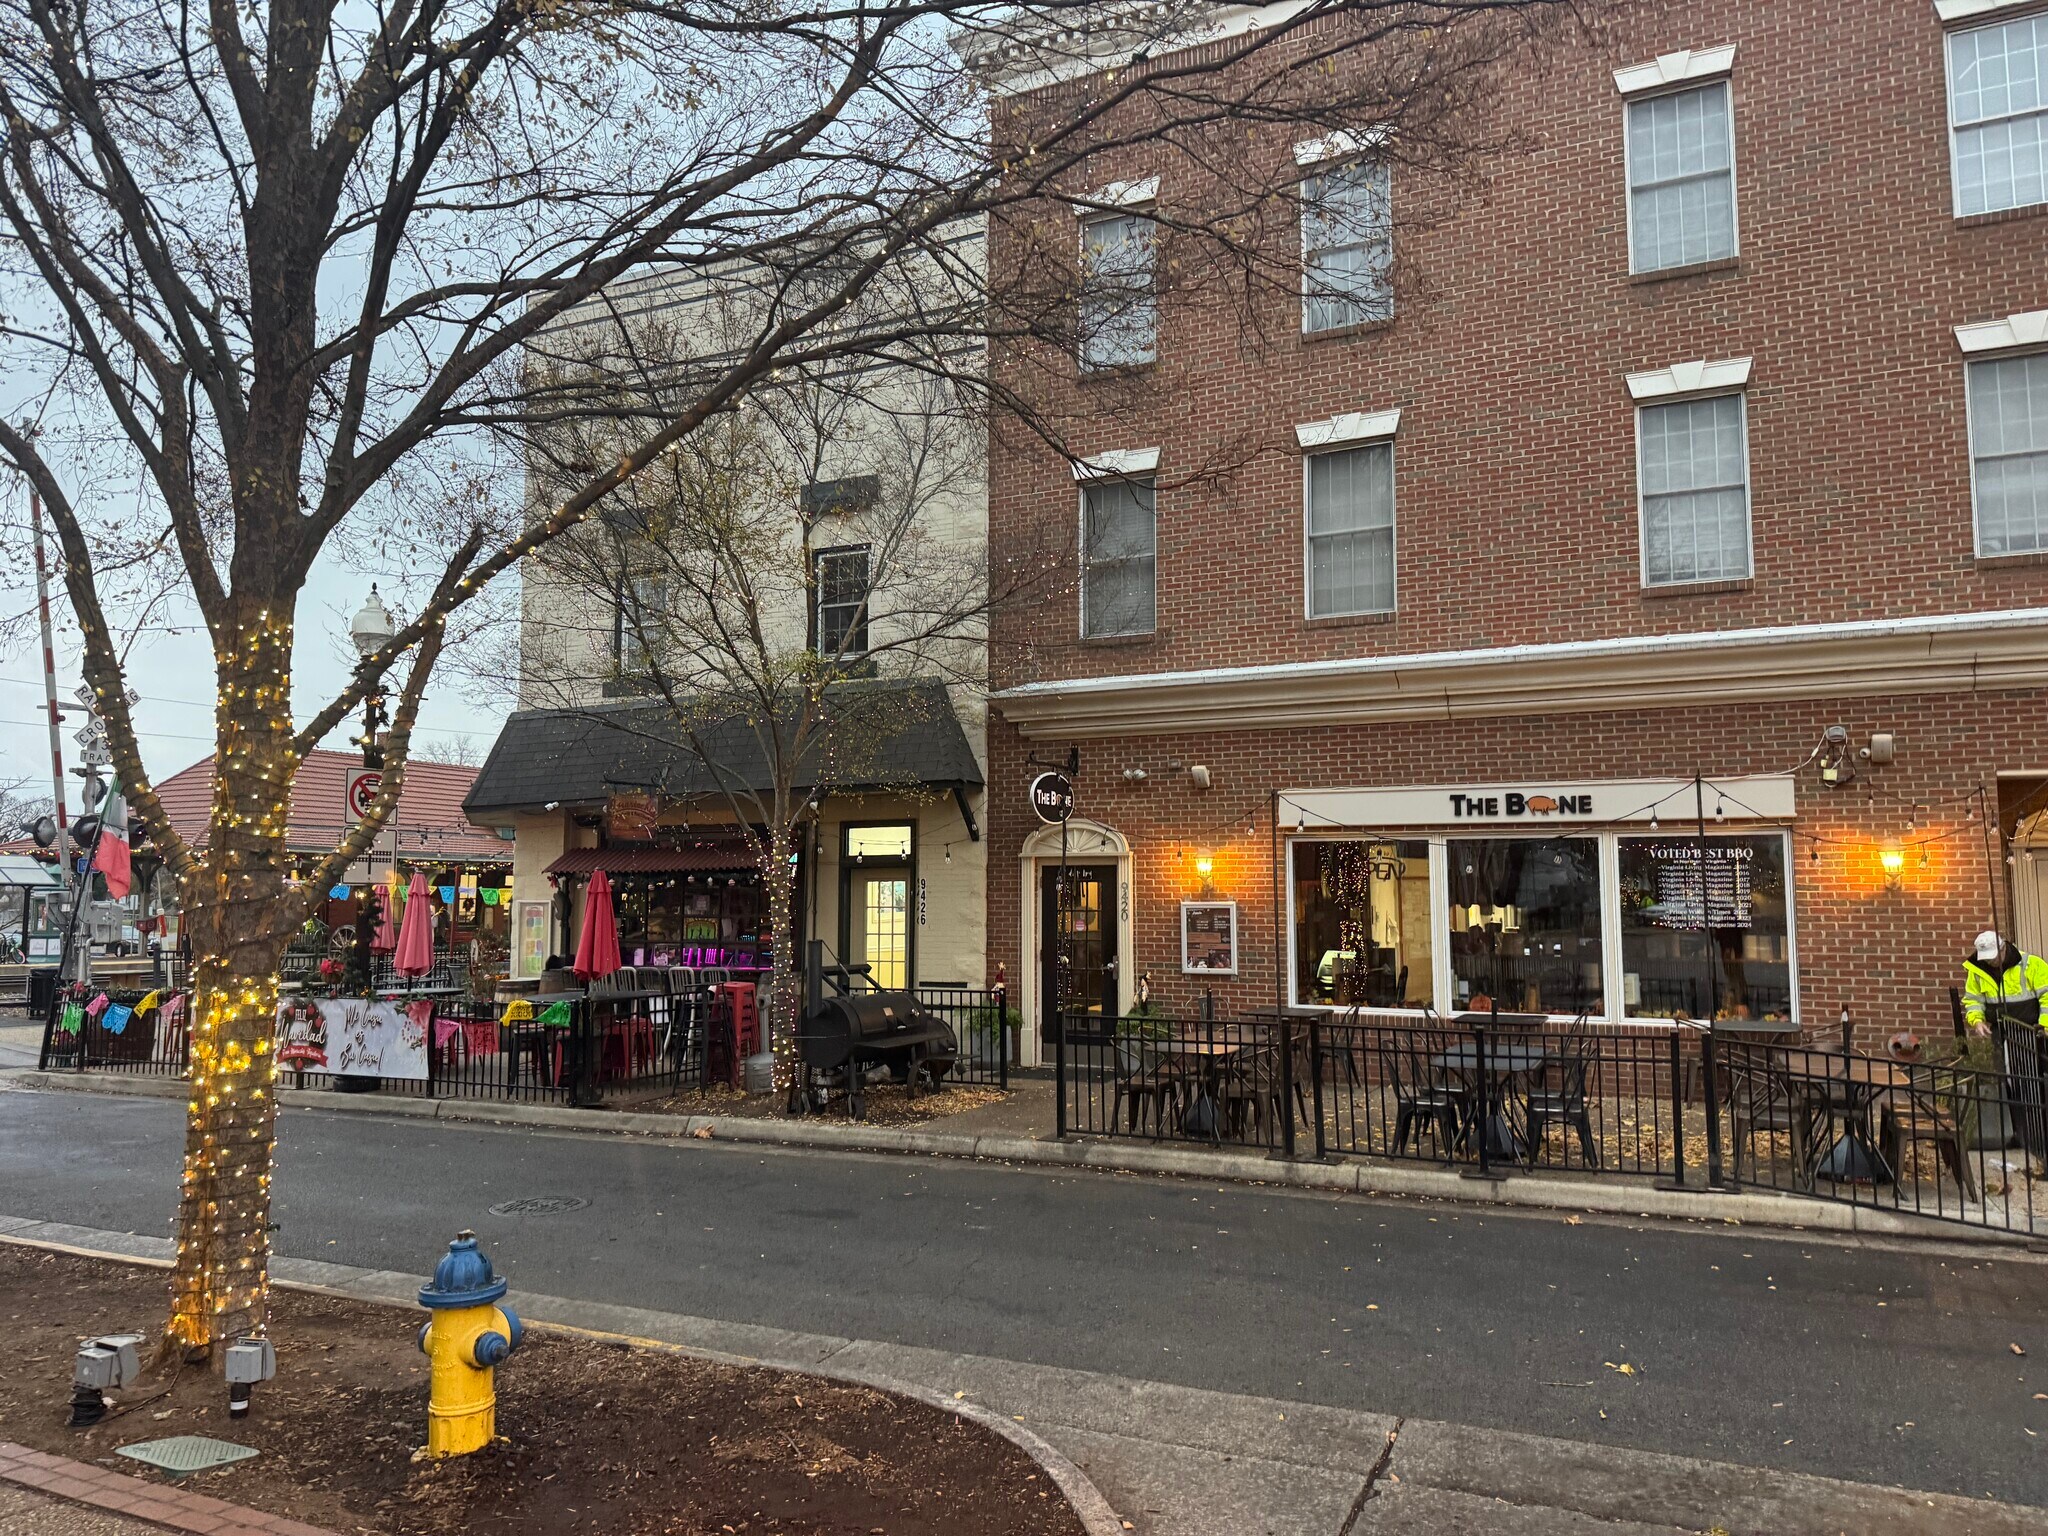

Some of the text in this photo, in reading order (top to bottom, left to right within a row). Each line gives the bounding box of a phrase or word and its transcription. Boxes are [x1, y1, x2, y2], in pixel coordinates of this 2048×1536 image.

[82, 752, 113, 762] TRAC
[1036, 789, 1072, 807] THE BE
[1450, 793, 1592, 816] THE BNE
[1650, 848, 1691, 859] VOTED
[1726, 847, 1754, 860] BBQ
[1120, 881, 1129, 922] 9420
[278, 1017, 328, 1048] Navidad
[354, 1029, 365, 1043] es
